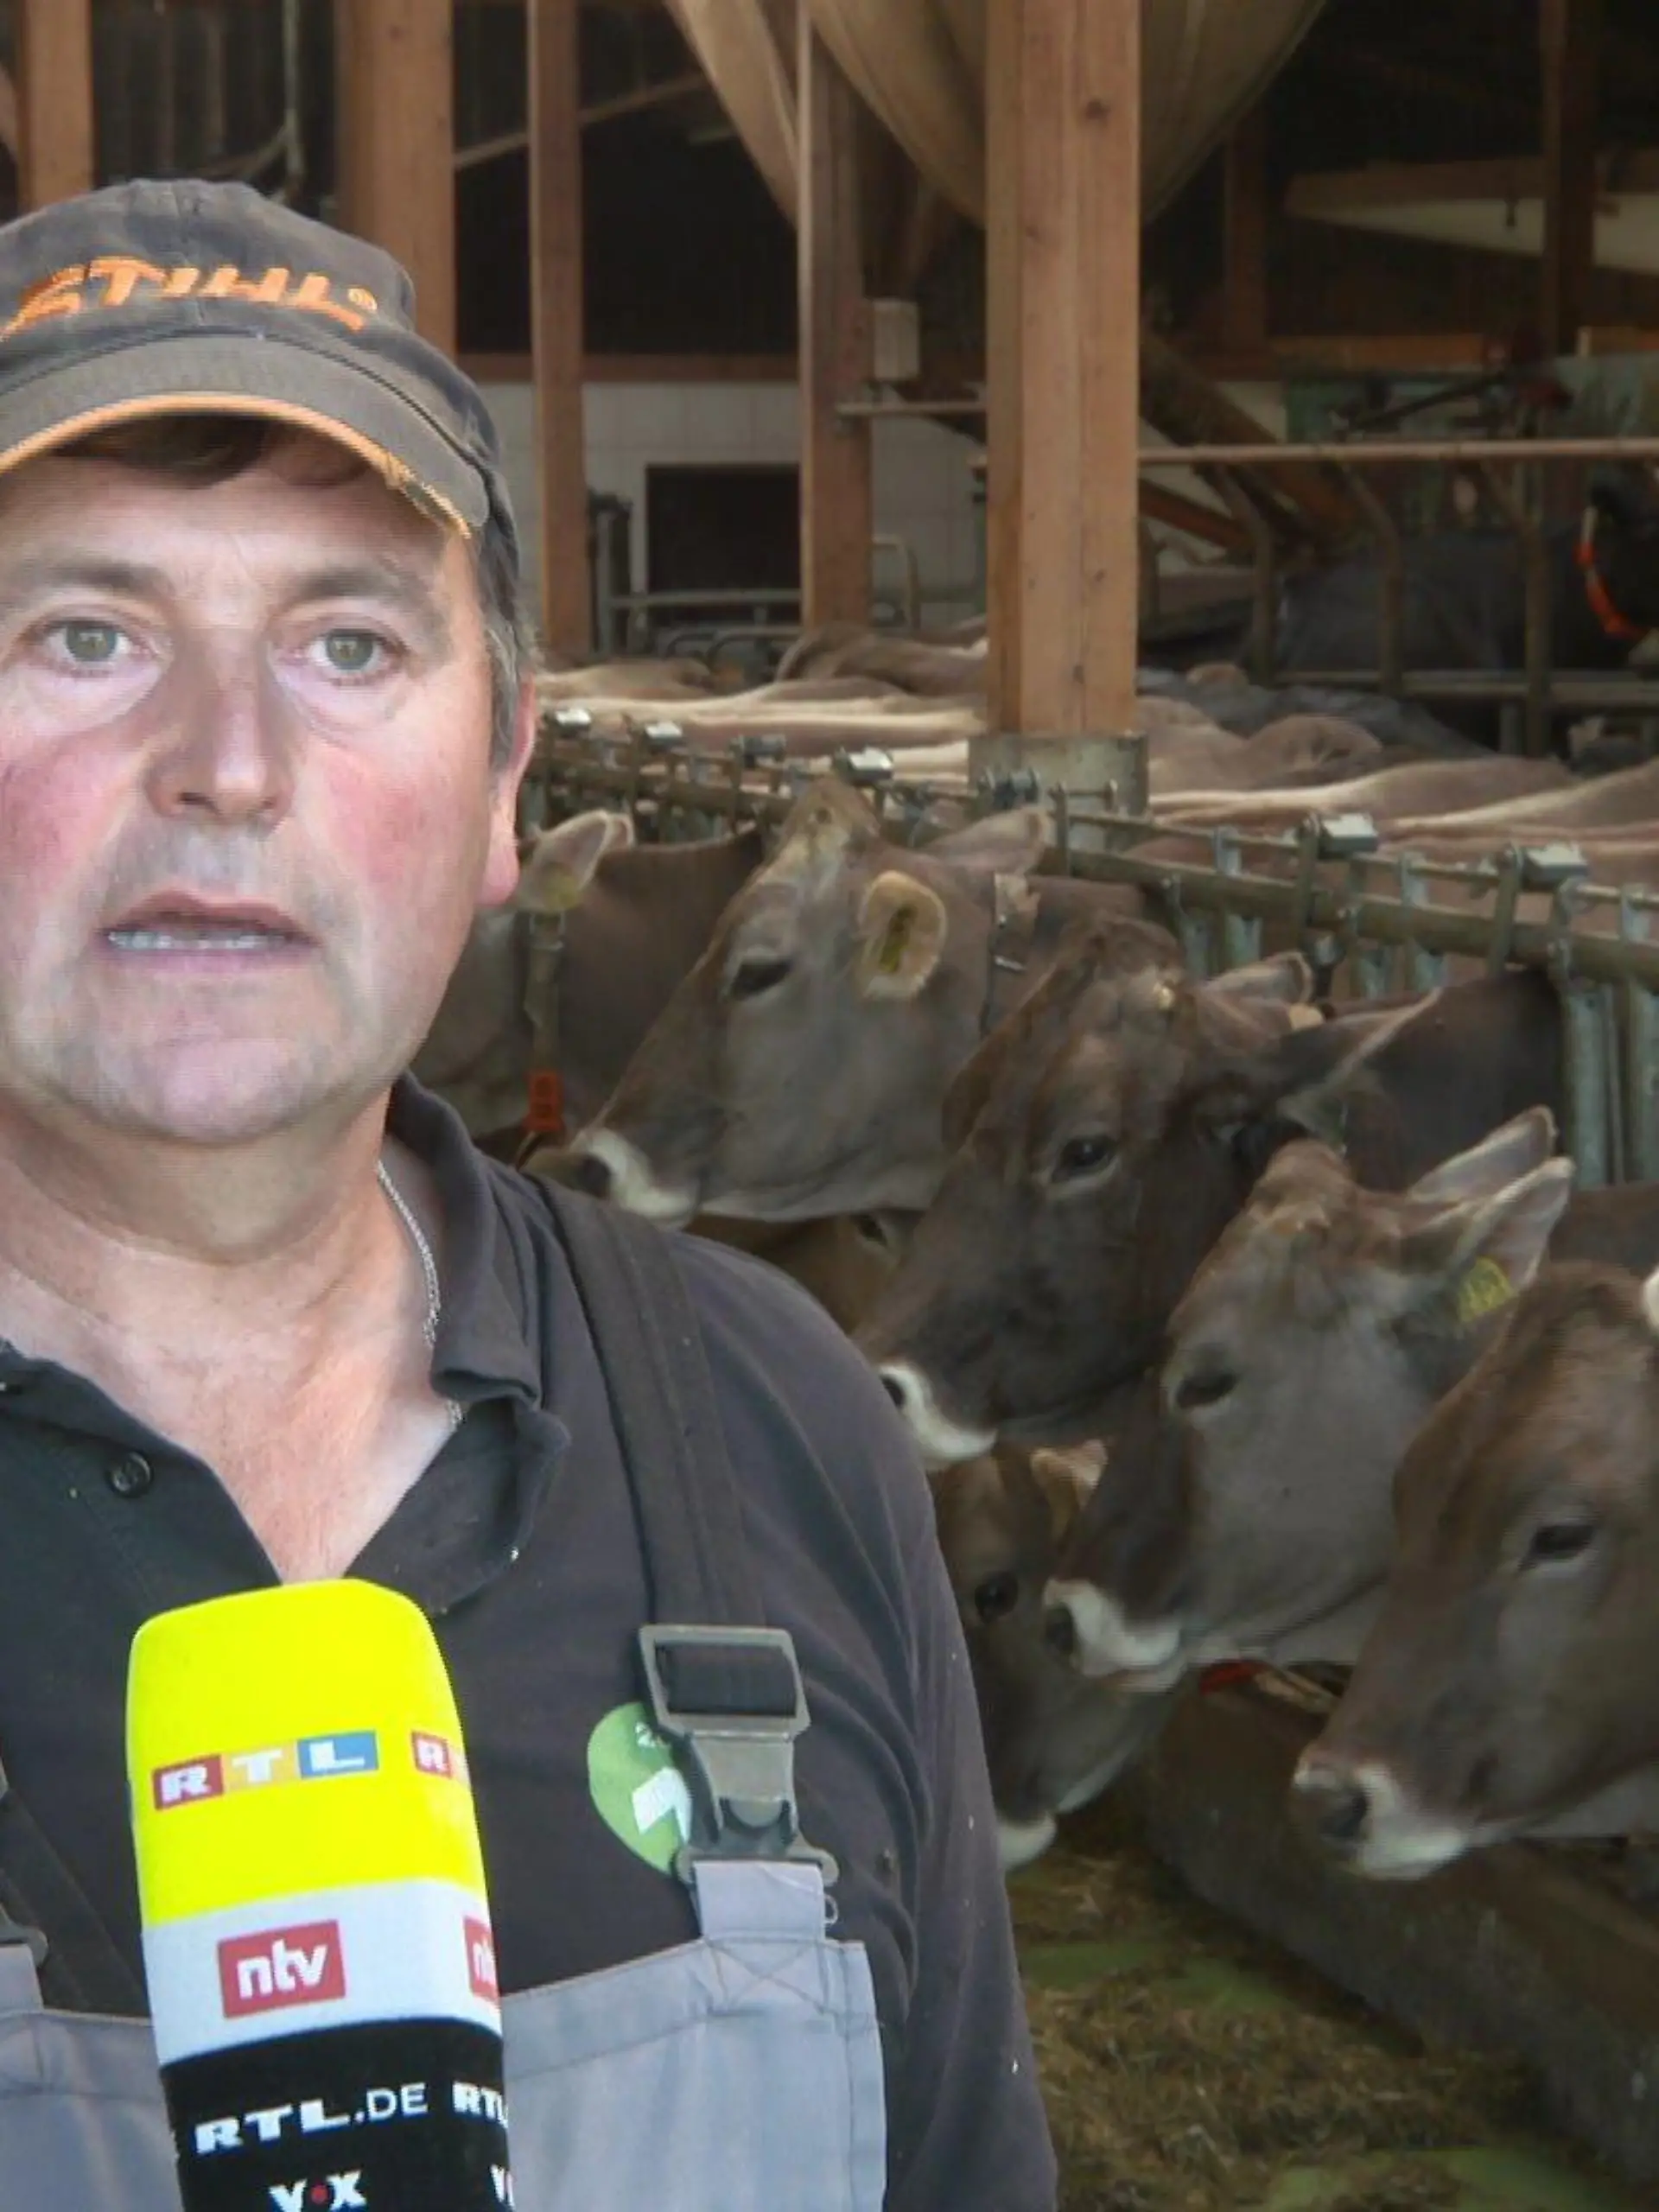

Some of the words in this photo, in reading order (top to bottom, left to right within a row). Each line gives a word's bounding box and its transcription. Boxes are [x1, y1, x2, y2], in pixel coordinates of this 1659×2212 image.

[159, 1740, 366, 1804] RTL
[237, 1940, 327, 2000] ntv
[194, 2082, 429, 2155] RTL.DE
